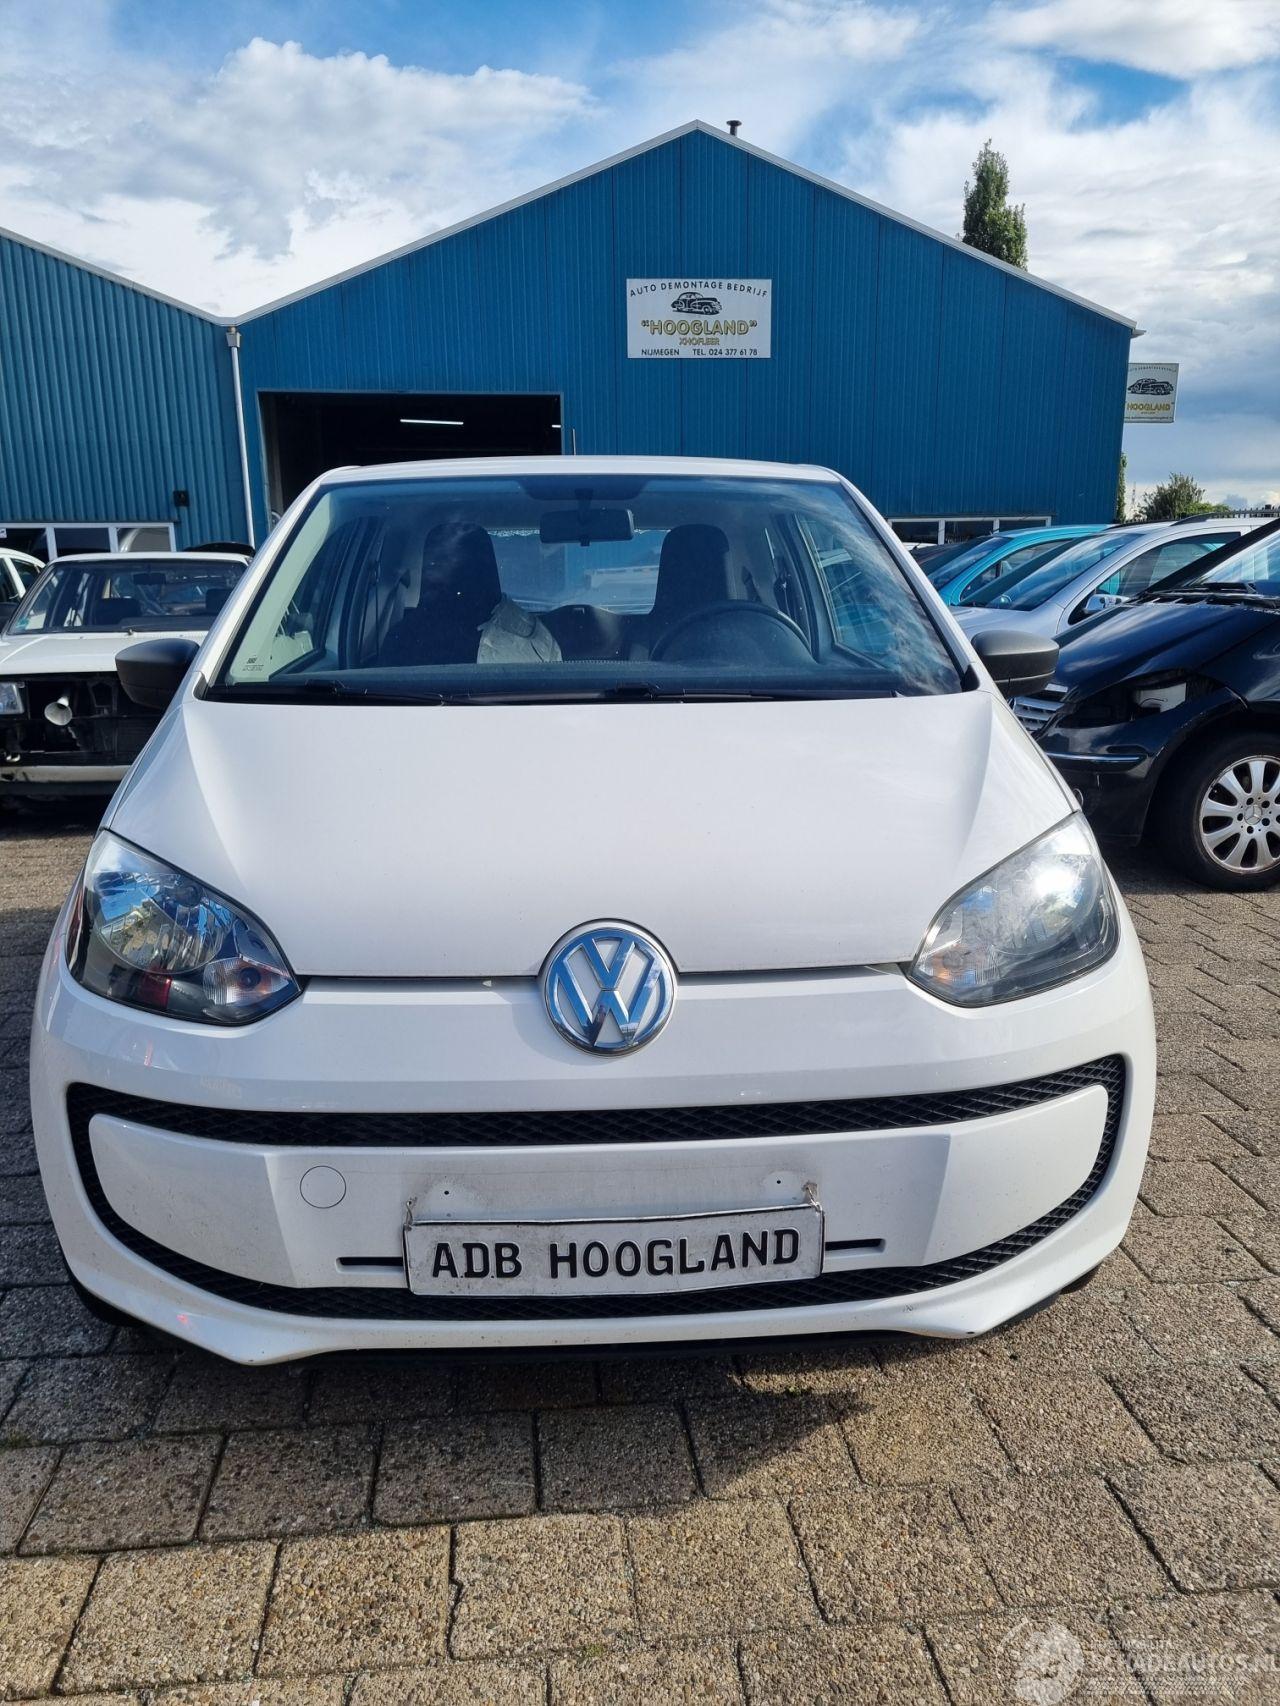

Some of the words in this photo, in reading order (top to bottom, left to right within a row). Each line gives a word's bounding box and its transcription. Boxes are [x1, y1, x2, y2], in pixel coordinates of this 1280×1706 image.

[630, 284, 657, 297] AUTO
[660, 281, 723, 291] DEMONTAGE
[726, 282, 768, 298] BEDRIJF
[641, 348, 680, 356] NIJMEGEN
[693, 348, 706, 356] TEL.
[708, 348, 723, 356] 024
[725, 348, 738, 356] 377
[739, 348, 747, 356] 61
[749, 348, 758, 356] 78
[549, 929, 669, 1050] VW
[549, 1228, 800, 1278] HOOGLAND
